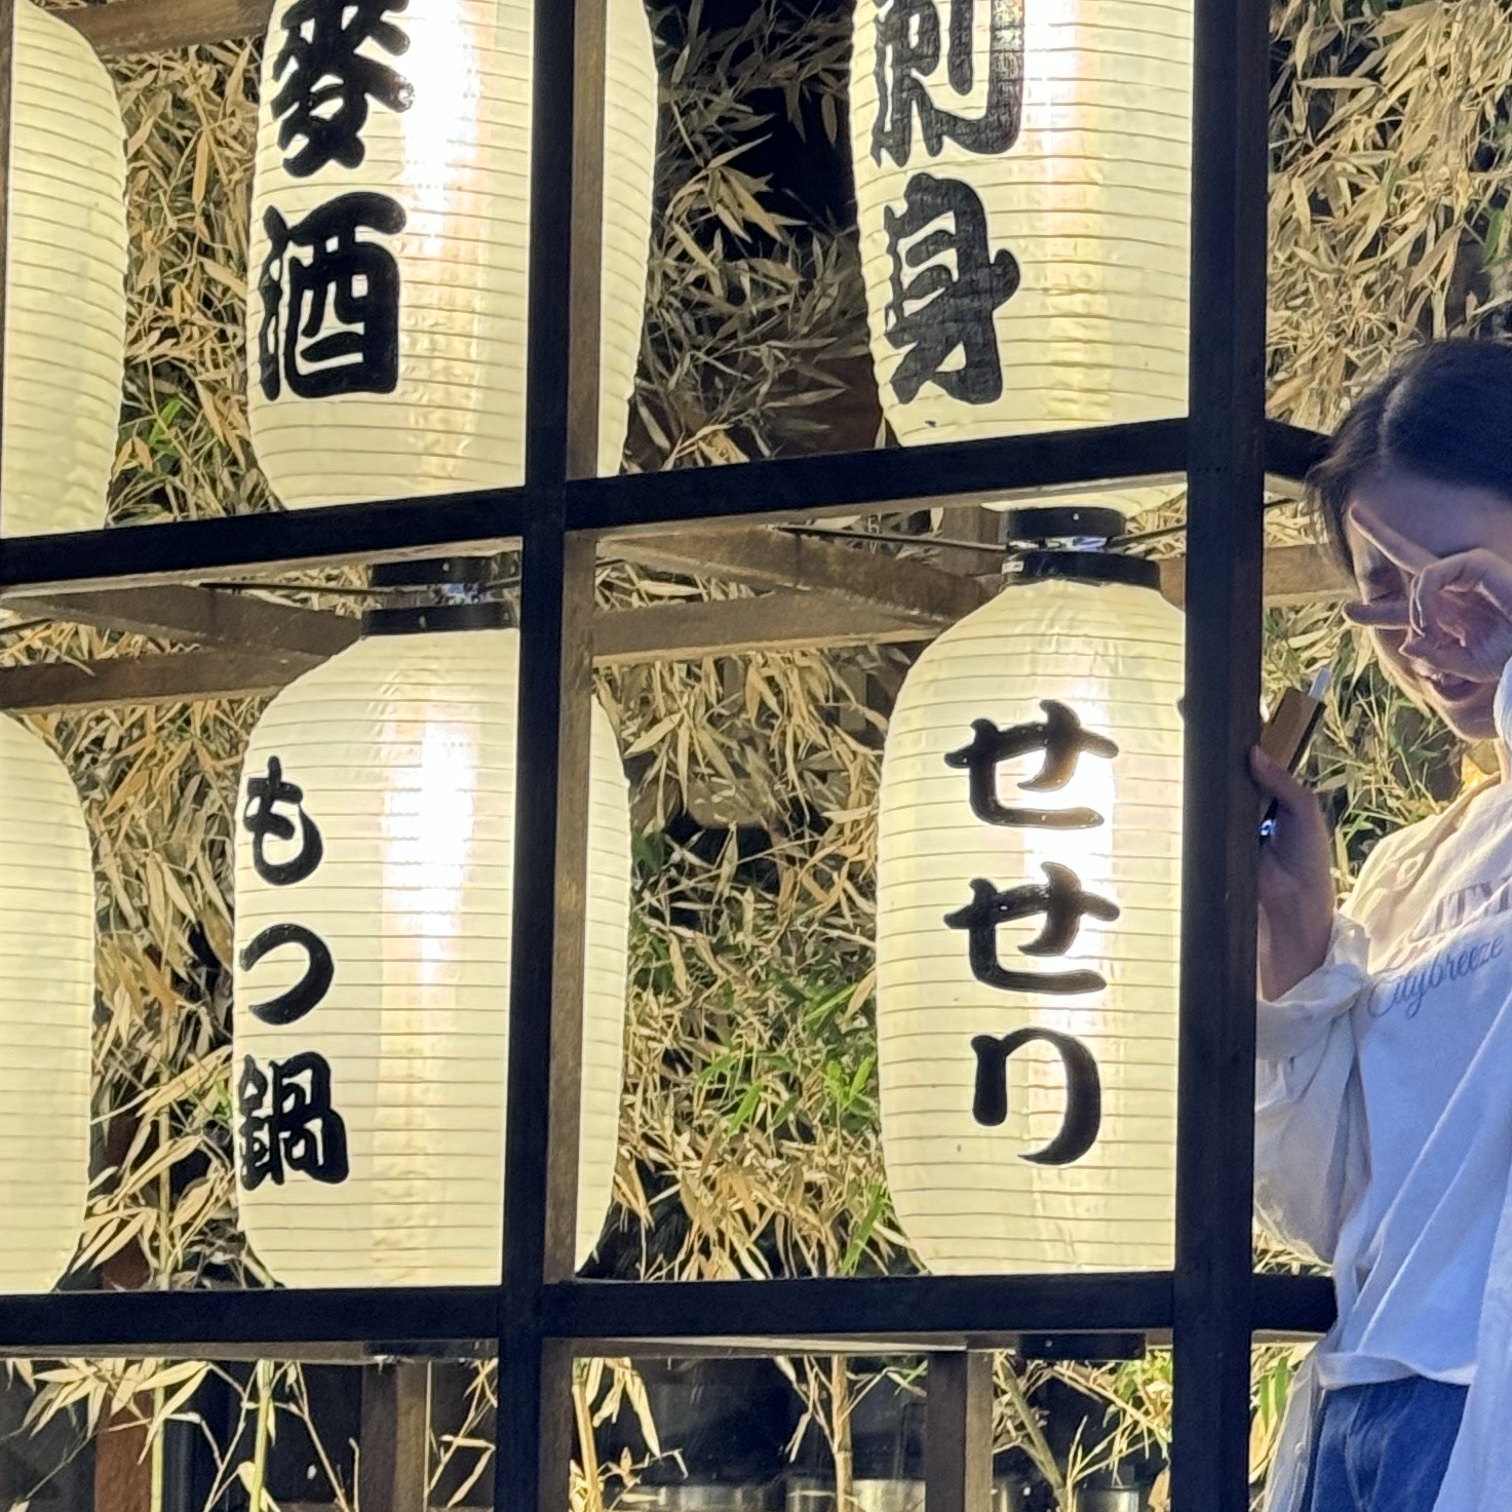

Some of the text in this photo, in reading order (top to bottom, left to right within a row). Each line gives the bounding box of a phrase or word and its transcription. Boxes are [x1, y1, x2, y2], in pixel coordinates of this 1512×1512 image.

[241, 756, 350, 1191] もつ鍋
[944, 699, 1120, 1166] せせり
